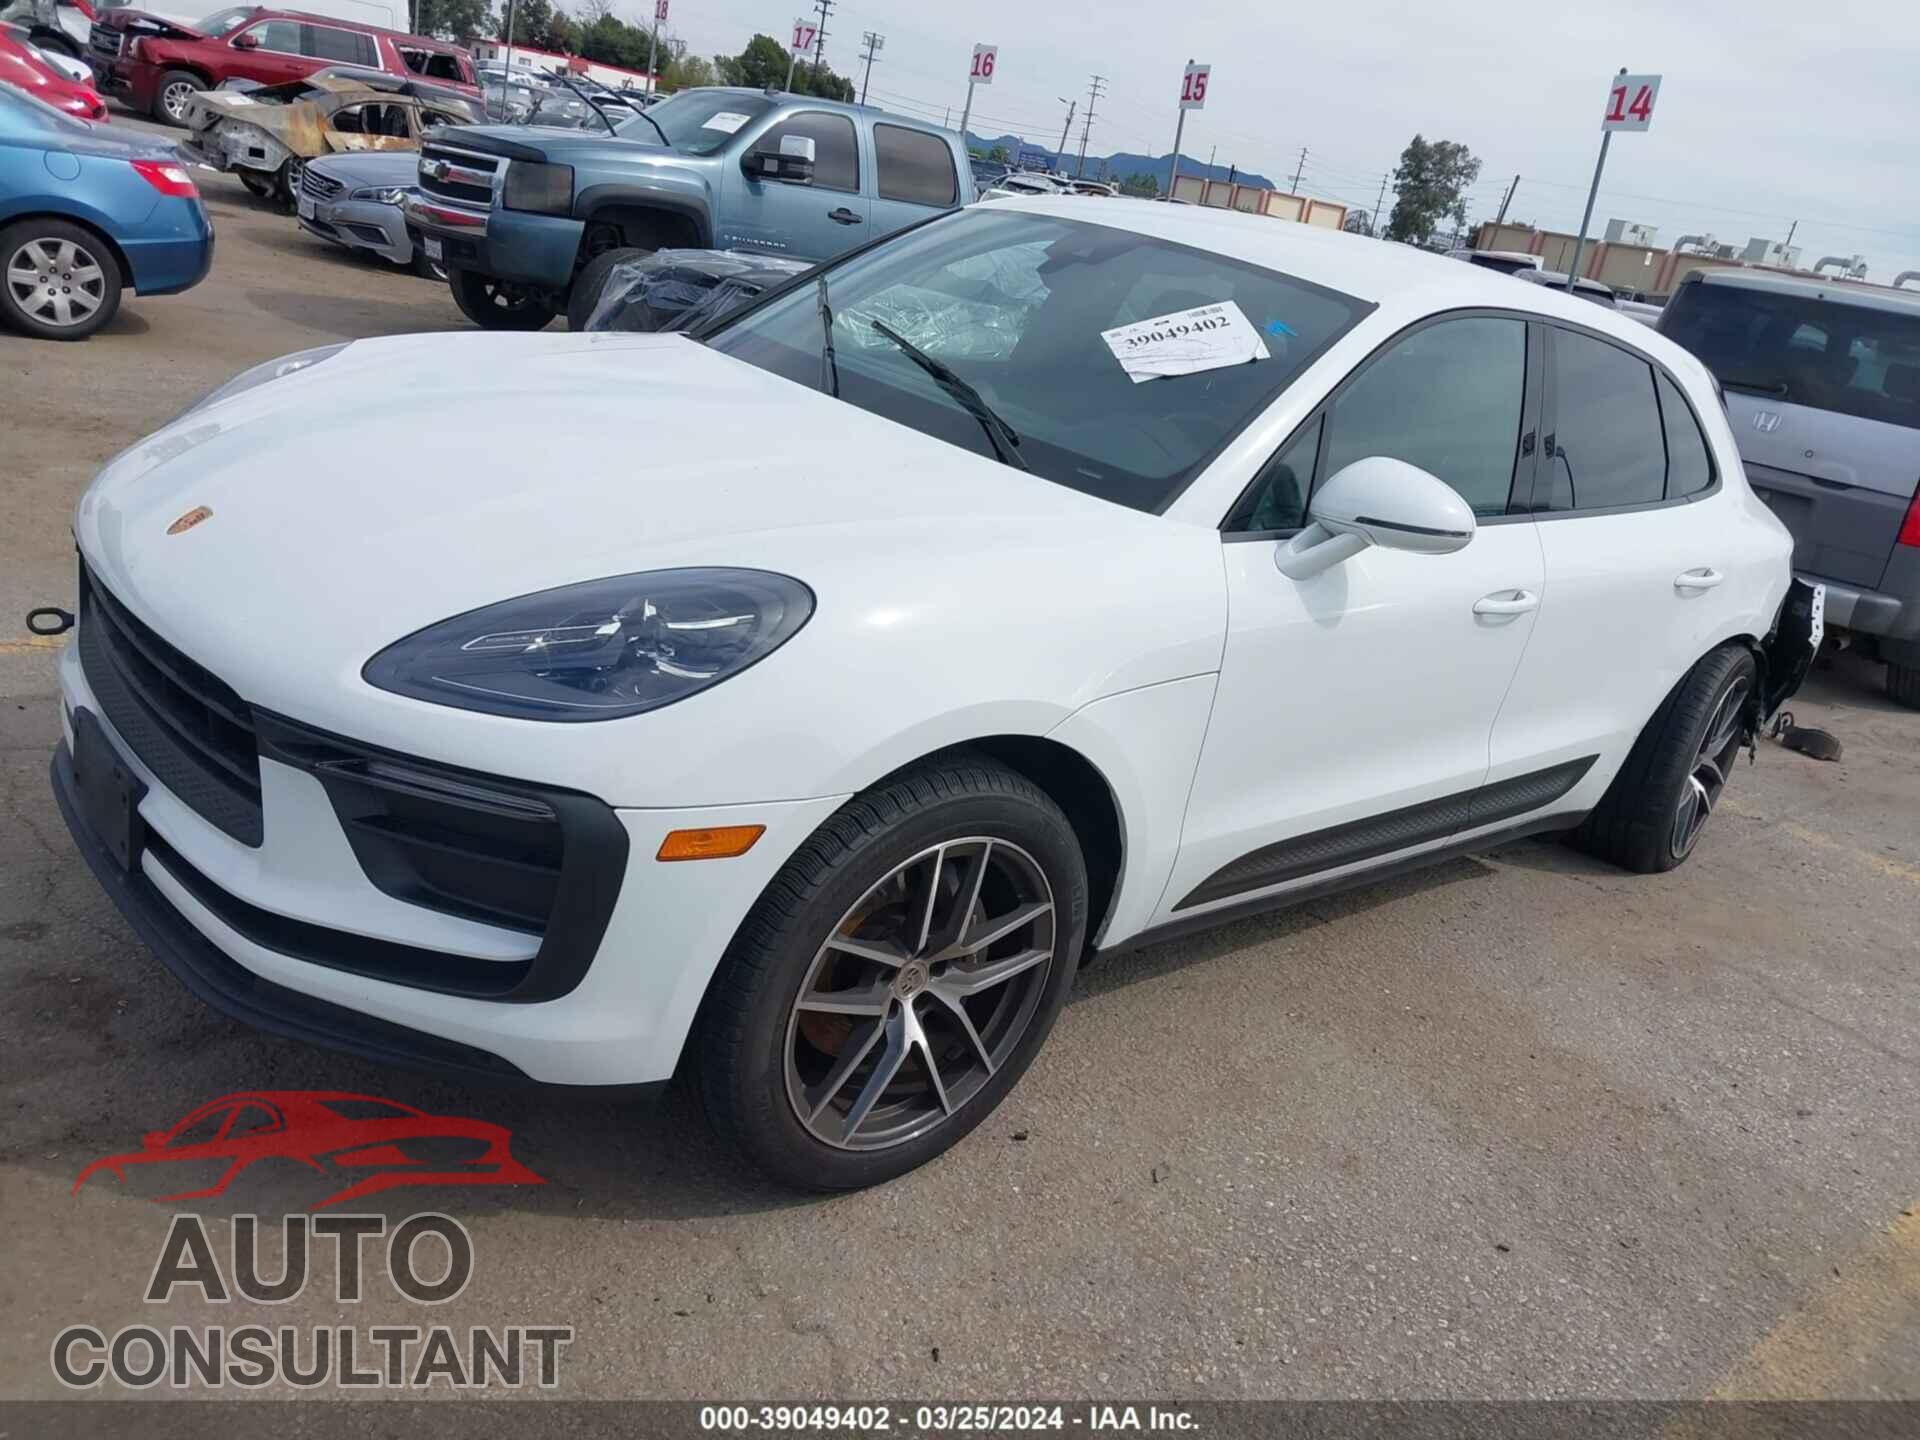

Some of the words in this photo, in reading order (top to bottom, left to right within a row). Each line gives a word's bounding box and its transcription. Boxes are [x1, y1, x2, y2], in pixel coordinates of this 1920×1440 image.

[655, 0, 668, 20] 18
[792, 27, 816, 50] 17
[970, 53, 995, 77] 16
[1181, 72, 1207, 101] 15
[1606, 85, 1652, 122] 14
[1124, 315, 1231, 350] 39049402
